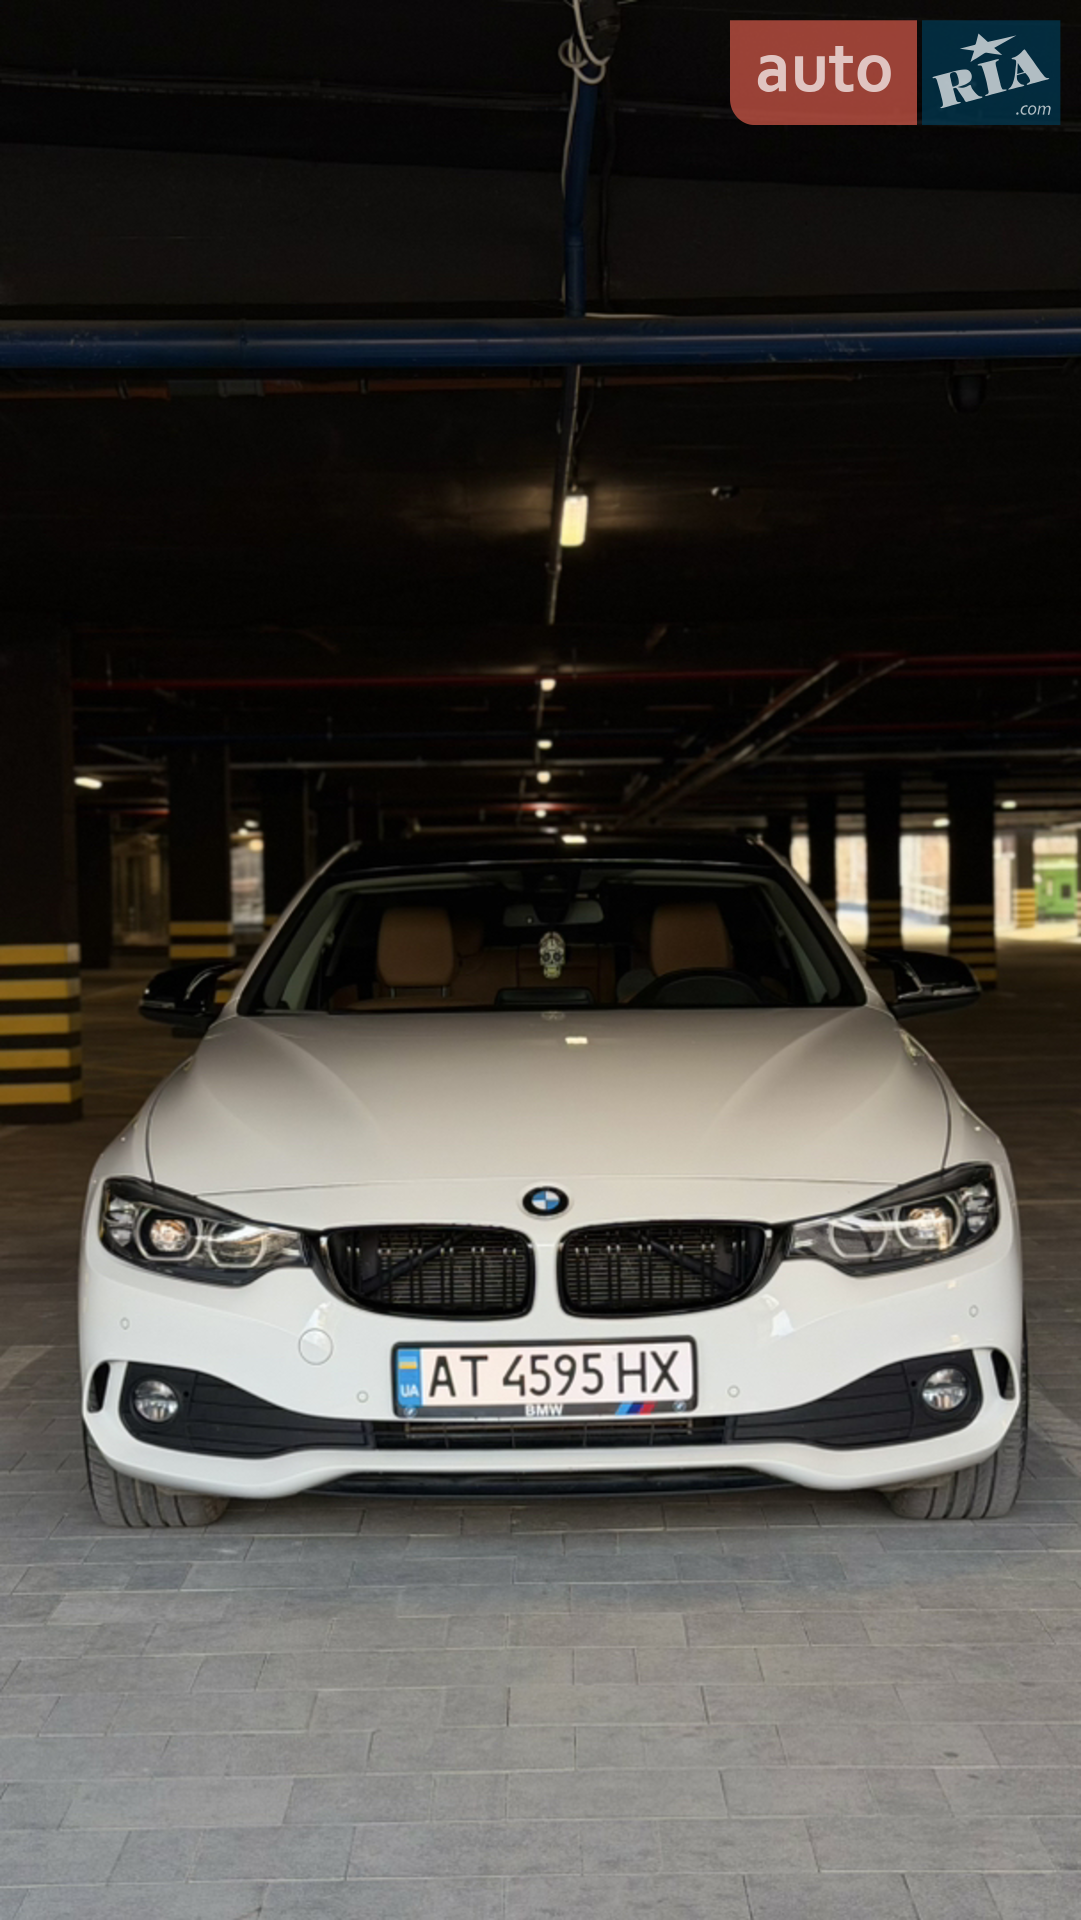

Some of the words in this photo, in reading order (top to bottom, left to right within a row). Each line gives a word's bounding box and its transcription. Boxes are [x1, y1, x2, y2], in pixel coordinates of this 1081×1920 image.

[429, 1355, 489, 1398] AT
[502, 1353, 604, 1397] 4595
[617, 1350, 681, 1394] HX
[400, 1384, 420, 1398] UA
[525, 1403, 564, 1417] BMW
